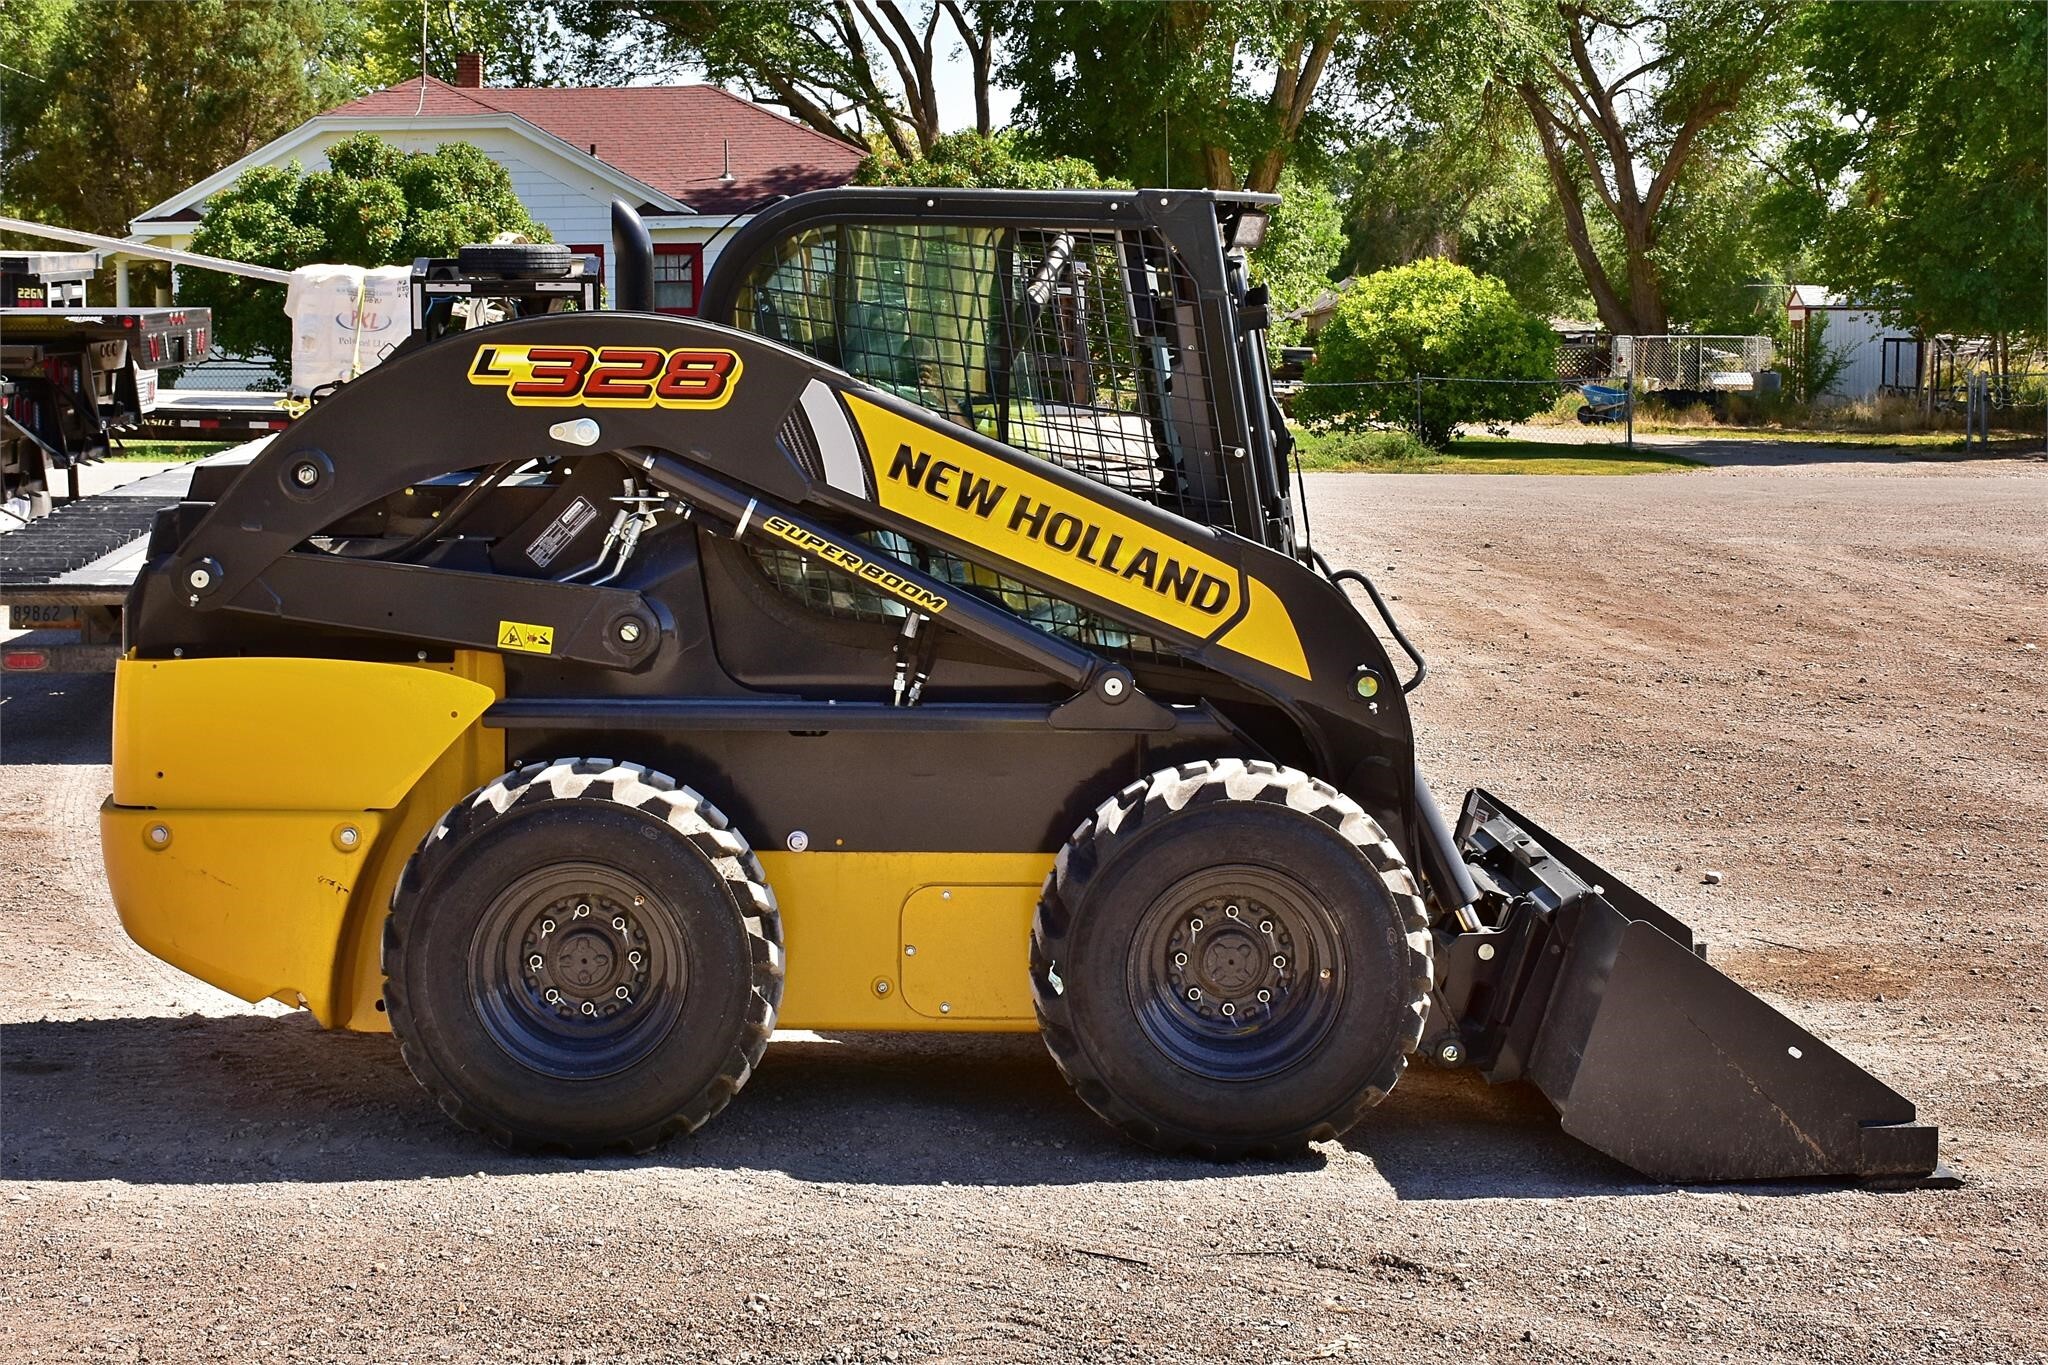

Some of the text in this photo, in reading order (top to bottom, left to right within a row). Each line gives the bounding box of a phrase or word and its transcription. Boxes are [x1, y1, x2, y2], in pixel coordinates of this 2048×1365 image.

[470, 346, 740, 402] L328
[765, 517, 946, 612] SUPER BOOM
[887, 443, 1232, 616] NEW HOLLAND
[13, 605, 60, 622] 89862
